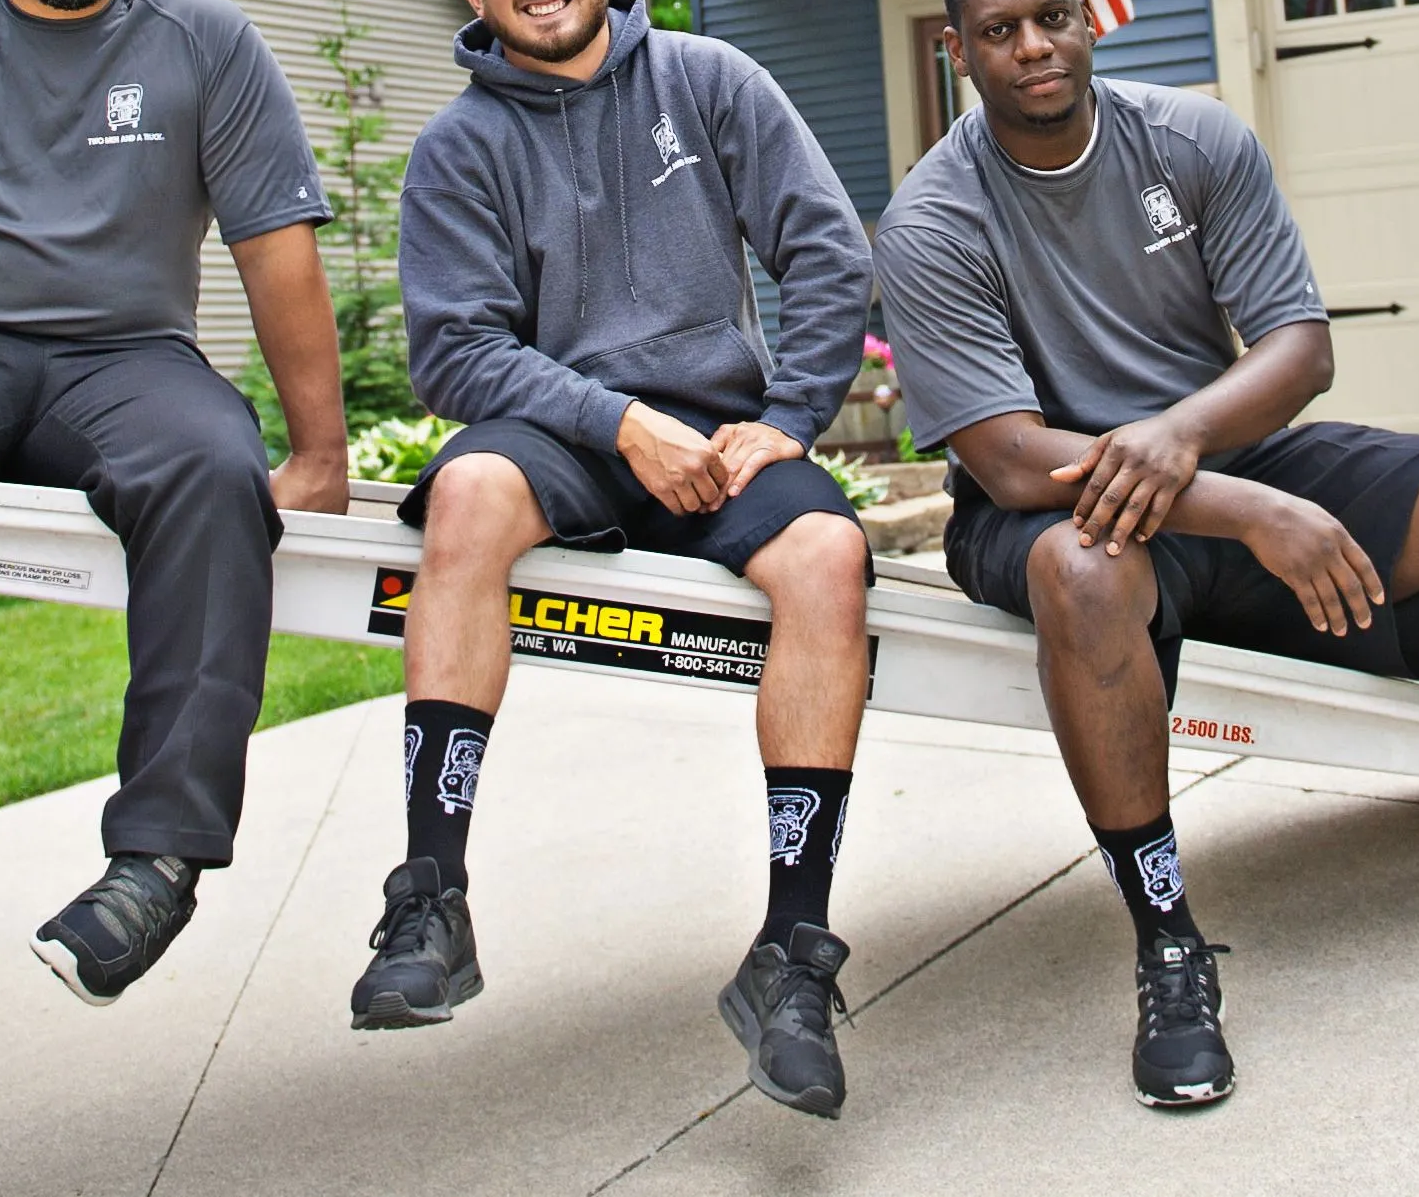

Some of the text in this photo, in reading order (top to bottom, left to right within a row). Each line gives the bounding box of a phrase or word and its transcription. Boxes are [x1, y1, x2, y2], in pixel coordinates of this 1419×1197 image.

[0, 563, 27, 572] SERIOUS
[28, 567, 51, 575] INJURY
[22, 573, 42, 581] RAMP
[670, 631, 769, 658] MANUFACTU
[552, 639, 577, 655] WA
[662, 653, 762, 679] 1-800-541-422
[1171, 716, 1255, 745] 2,500 LBS.
